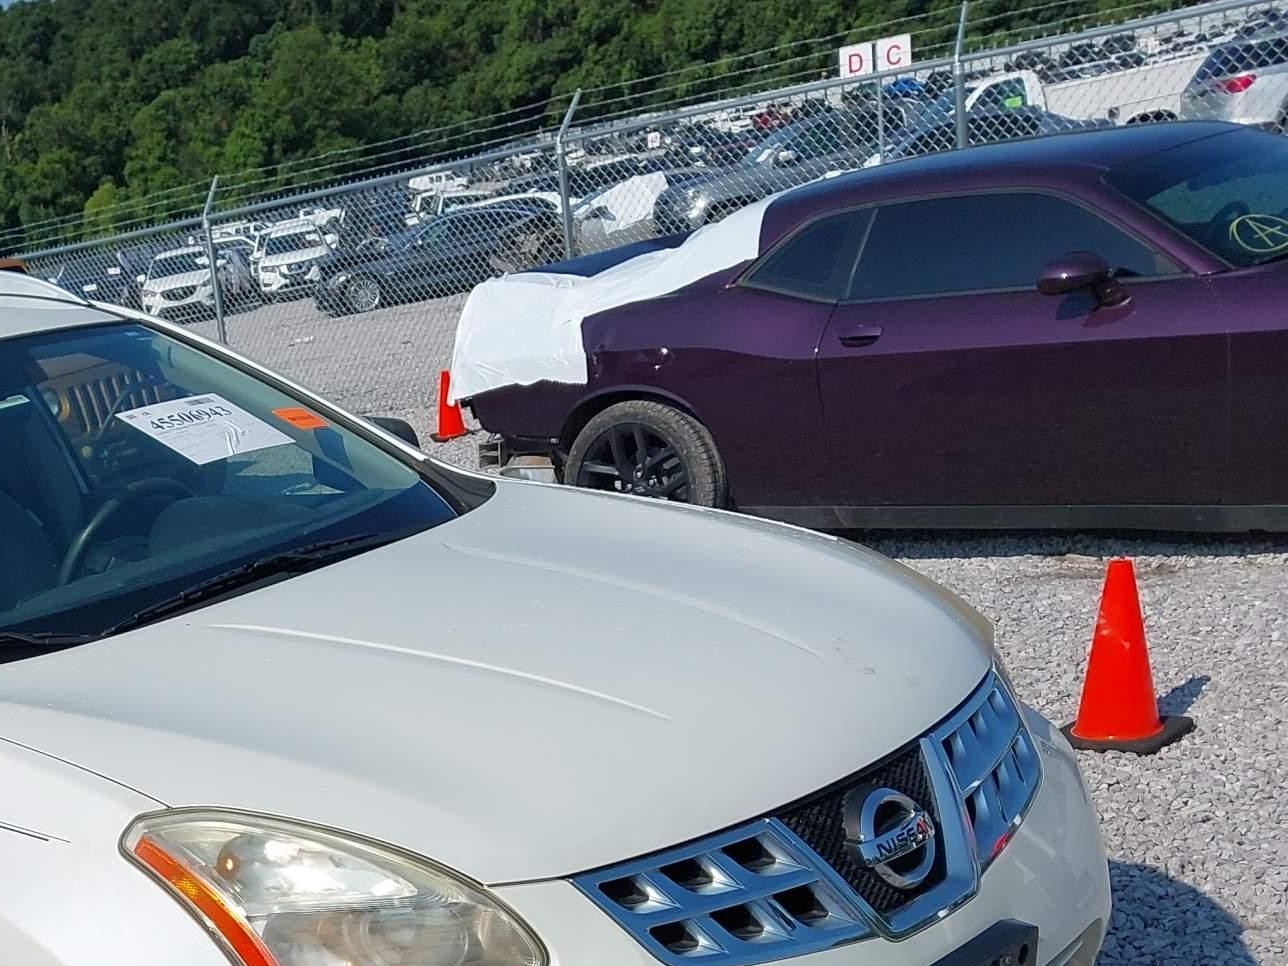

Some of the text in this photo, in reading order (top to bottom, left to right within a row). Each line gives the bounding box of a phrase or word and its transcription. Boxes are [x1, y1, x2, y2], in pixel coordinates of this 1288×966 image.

[848, 53, 863, 73] D
[886, 44, 902, 65] C
[150, 405, 233, 431] 45506943
